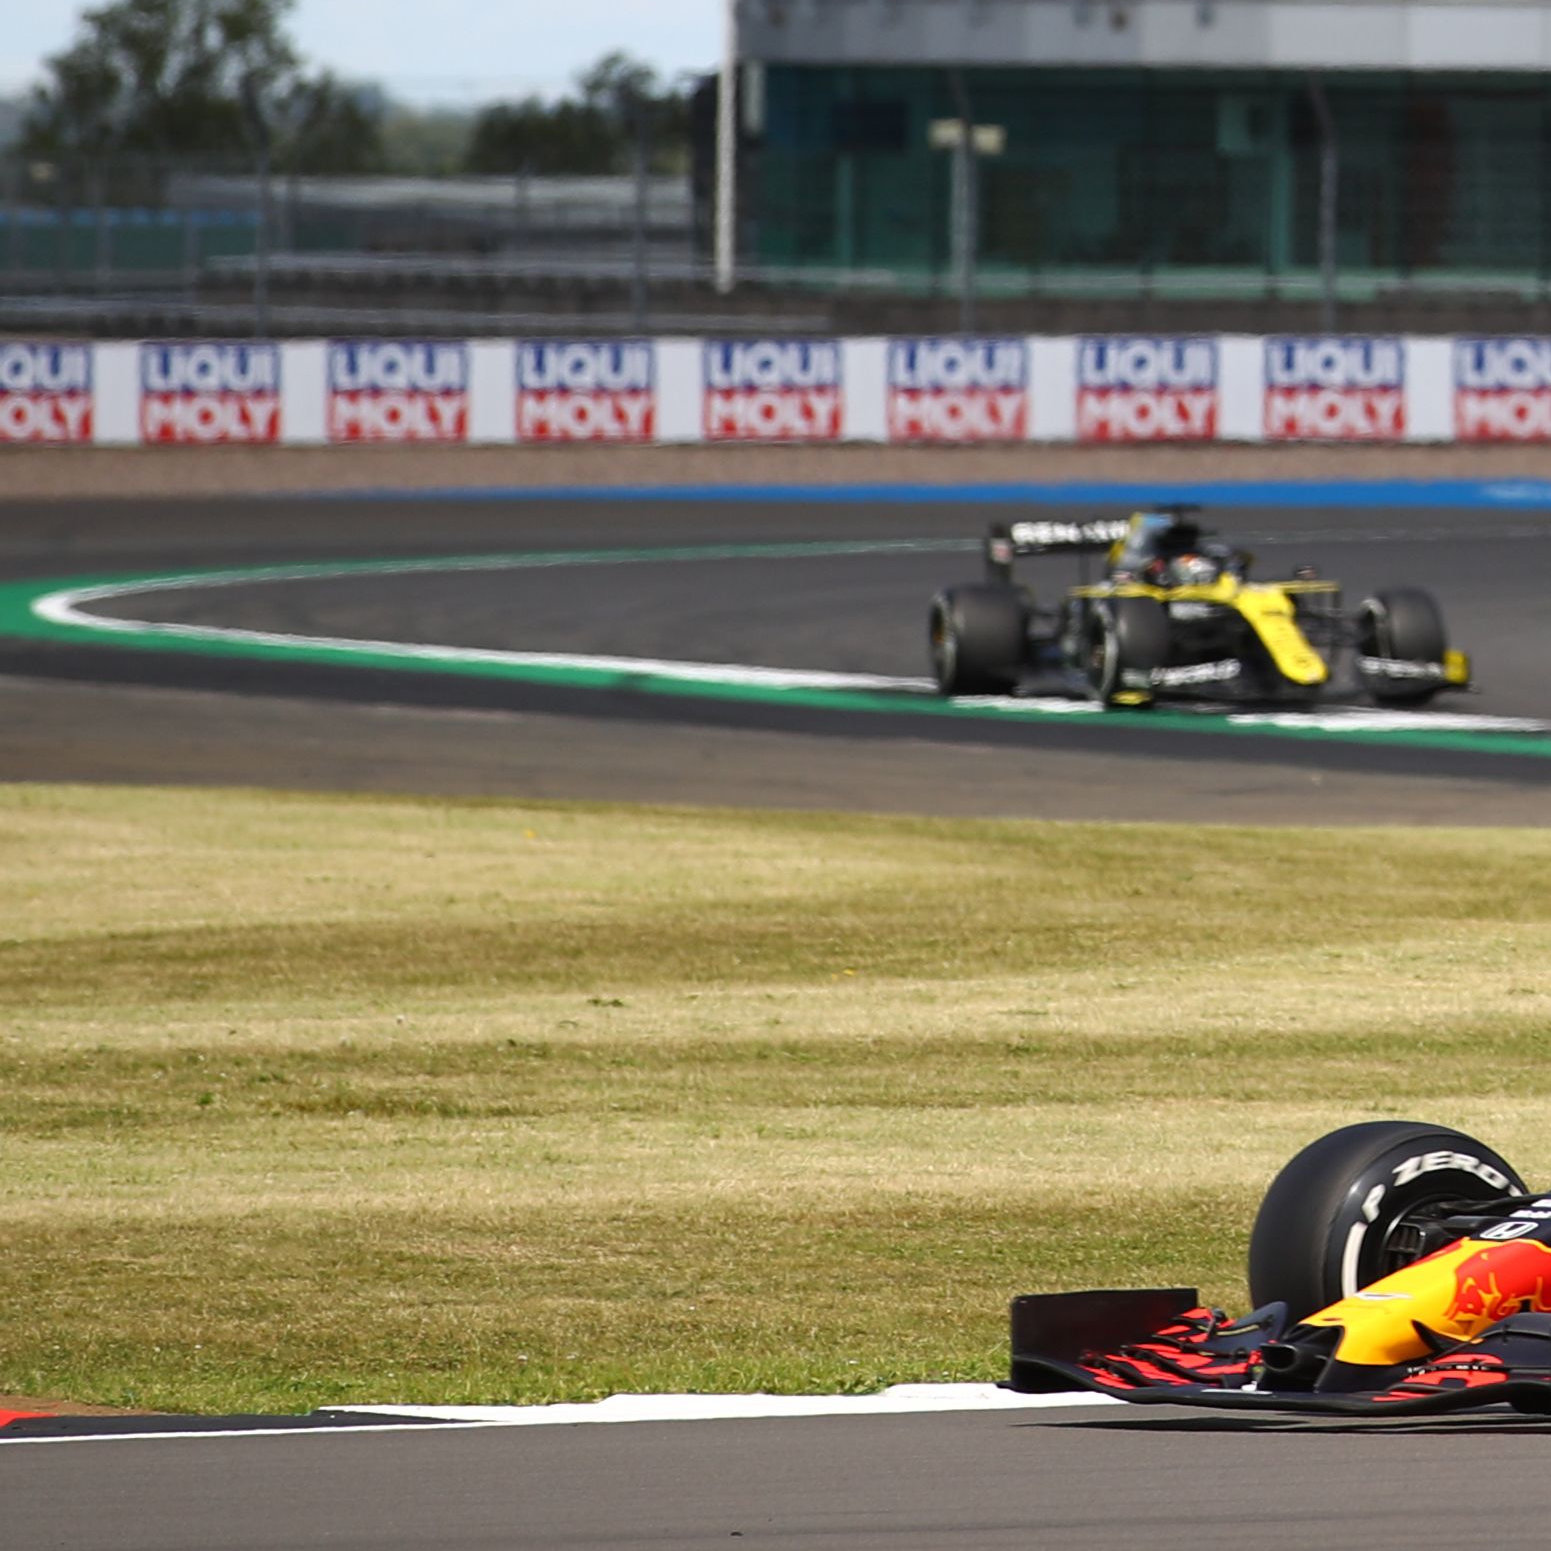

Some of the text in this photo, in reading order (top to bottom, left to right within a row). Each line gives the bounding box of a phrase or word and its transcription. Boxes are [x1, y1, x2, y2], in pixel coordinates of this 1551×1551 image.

[0, 348, 85, 390] QUI
[0, 396, 92, 441] OLY
[149, 396, 281, 441] MOLY
[337, 395, 469, 440] MOLY
[523, 394, 656, 439] MOLY
[711, 392, 843, 437] MOLY
[898, 393, 1027, 437] MOLY
[1084, 393, 1218, 439] MOLY
[1274, 392, 1406, 437] MOLY
[1391, 1150, 1510, 1190] ZERO
